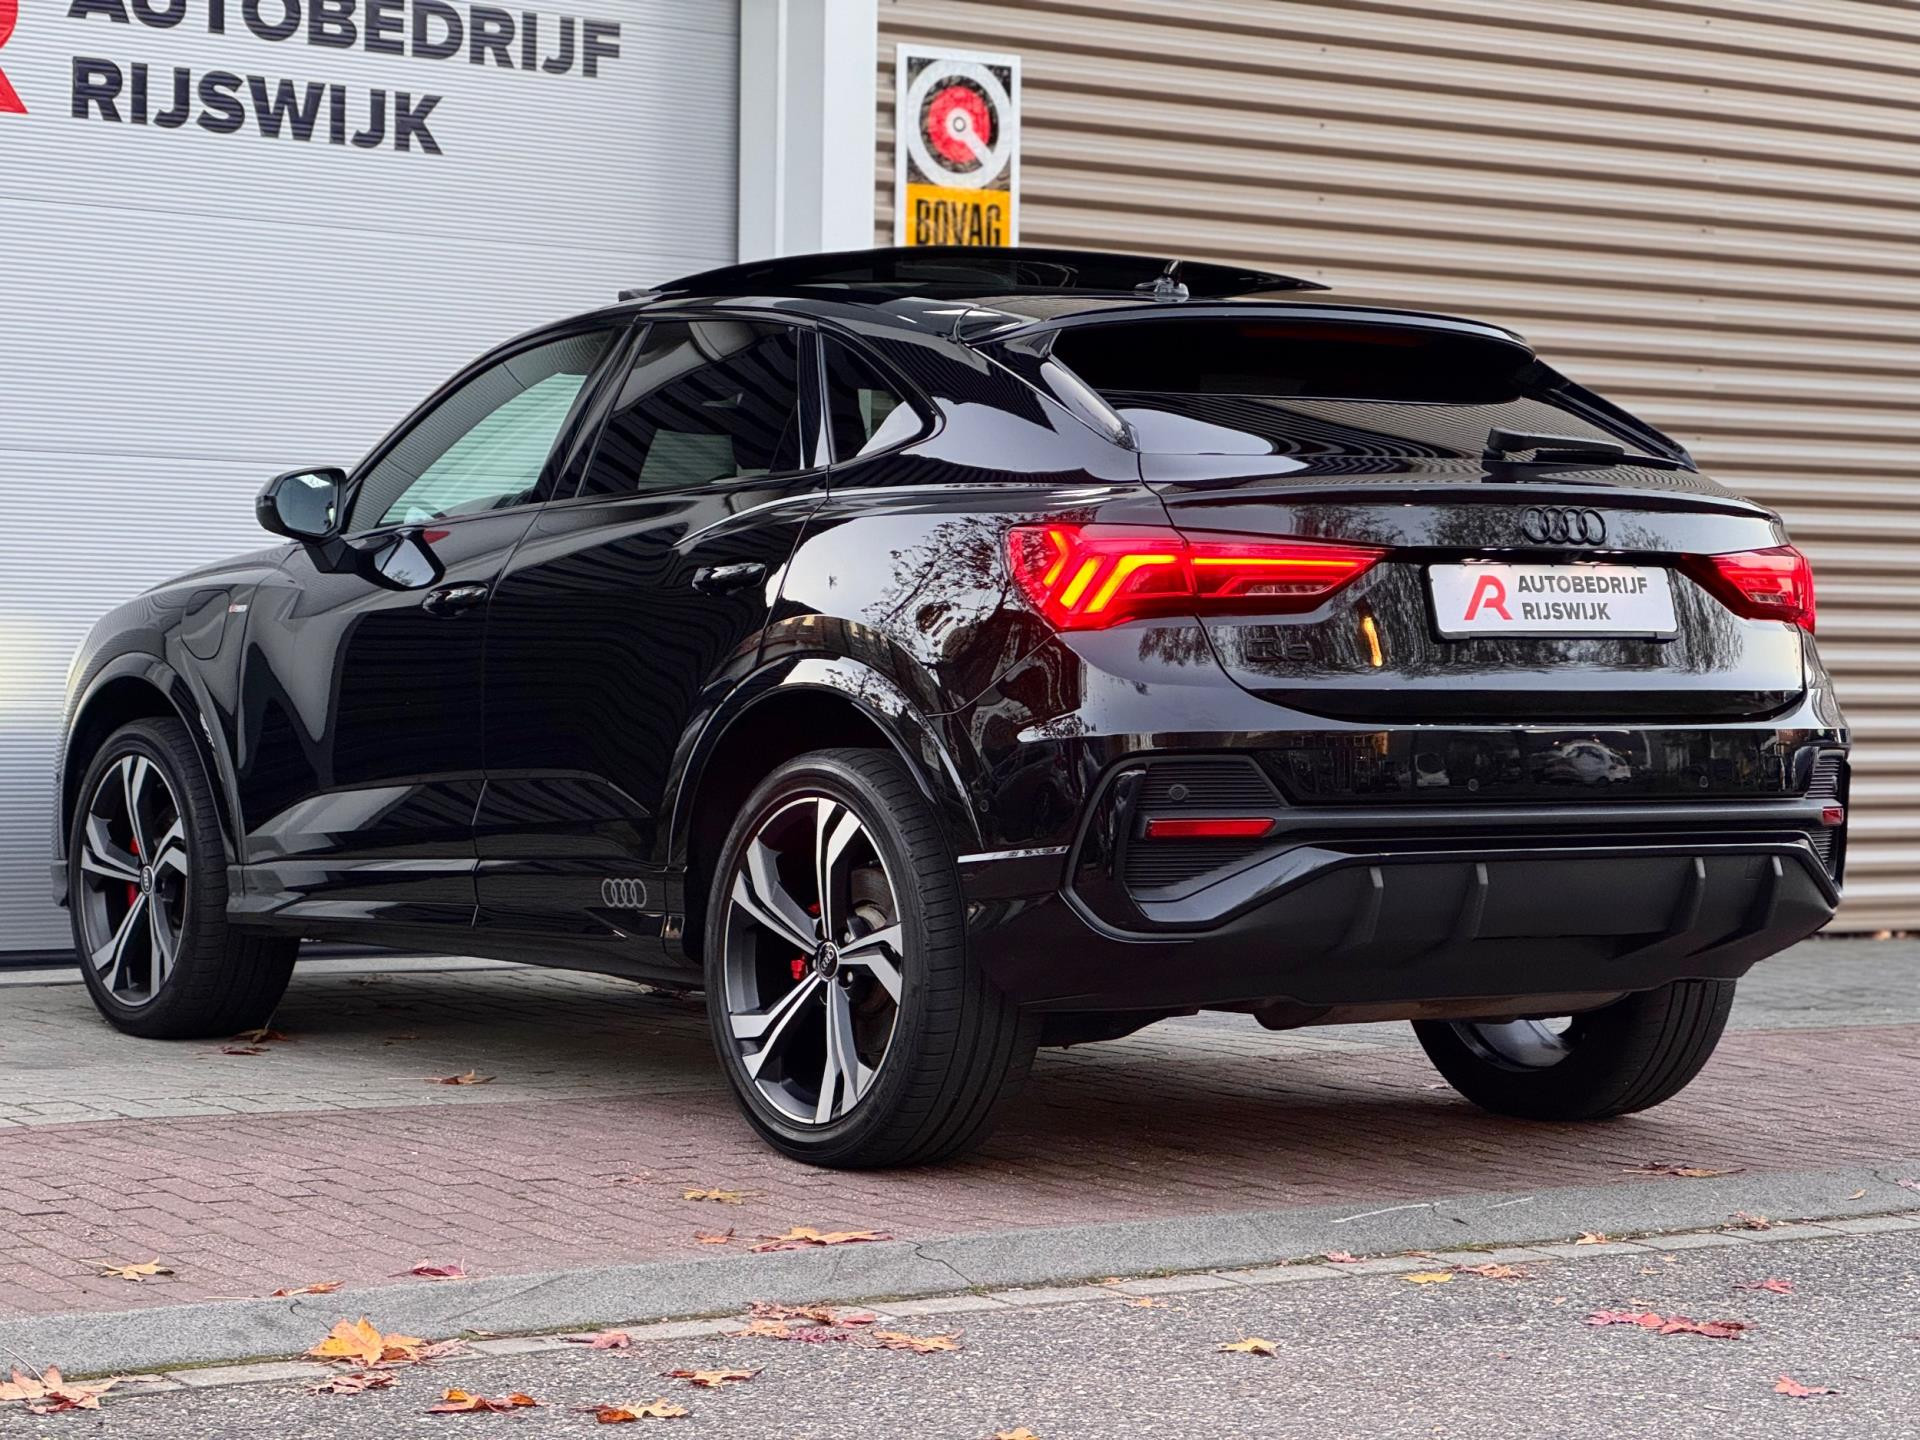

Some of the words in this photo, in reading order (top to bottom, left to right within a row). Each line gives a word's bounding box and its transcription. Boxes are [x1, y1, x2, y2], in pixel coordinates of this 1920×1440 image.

[71, 56, 443, 155] RIJSWIJK
[916, 198, 1001, 247] BOVAG
[1518, 575, 1648, 594] AUTOBEDRIJF
[1522, 602, 1611, 620] RIJSWIJK
